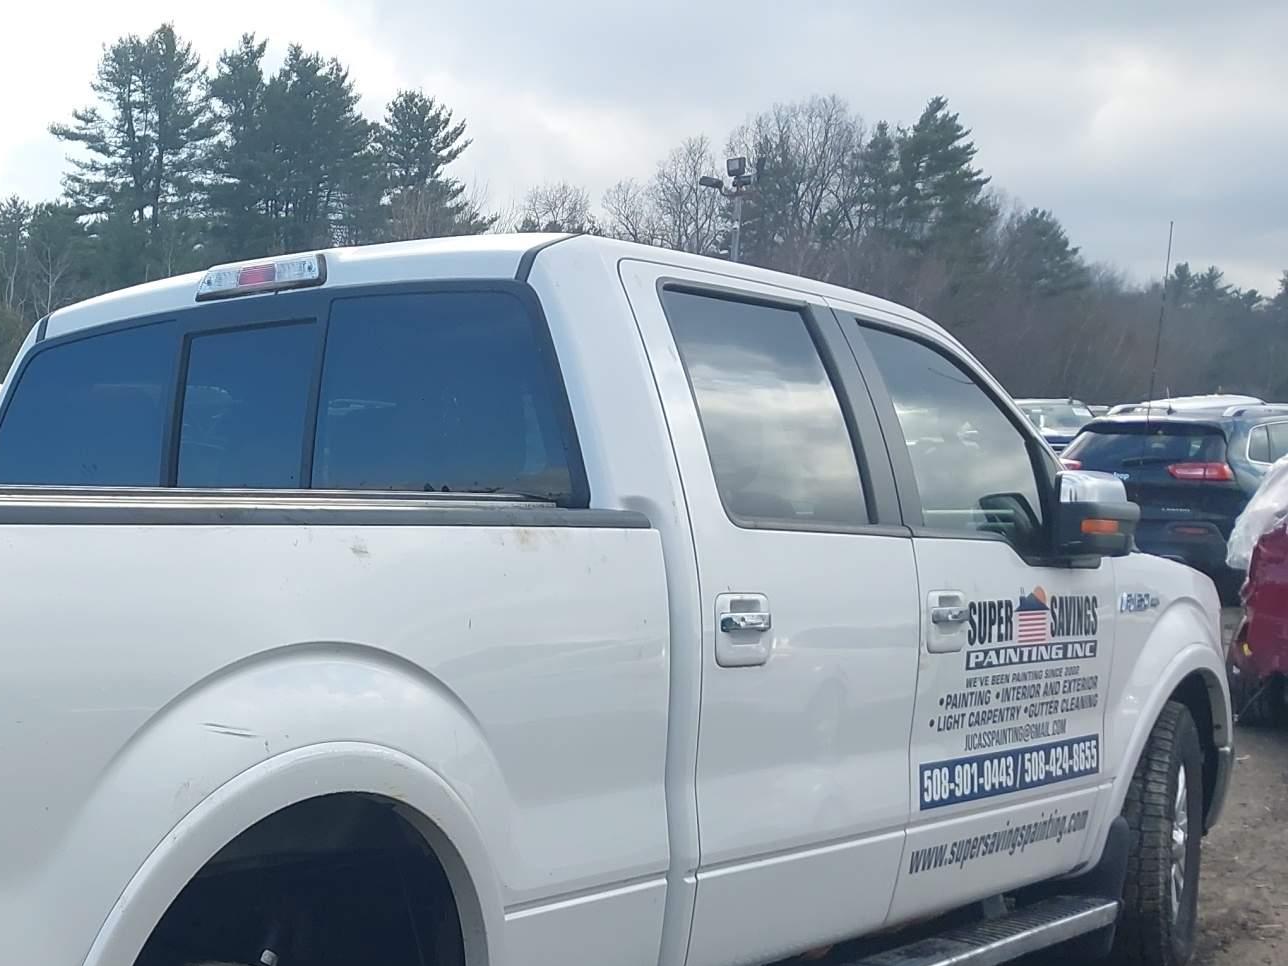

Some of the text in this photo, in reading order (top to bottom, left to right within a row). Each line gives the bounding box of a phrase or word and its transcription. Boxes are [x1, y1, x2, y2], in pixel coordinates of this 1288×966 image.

[968, 600, 1013, 646] SUPER
[1050, 595, 1098, 637] SAVINGS
[968, 642, 1096, 668] PAINTING INC
[945, 675, 1099, 710] PAINTING INTERIOR AND EXTERIOR
[965, 675, 990, 688] WE'VE
[991, 673, 1010, 685] BEEN
[1012, 669, 1043, 683] PAINTING
[1044, 667, 1063, 681] SINCE
[937, 693, 1099, 732] LIGHT CARPENTRY GUTTER CLEANING
[923, 755, 1014, 802] 508-901-0443
[1024, 739, 1097, 783] 508-424-8655
[908, 809, 1089, 875] www.supersavingspainting.com
